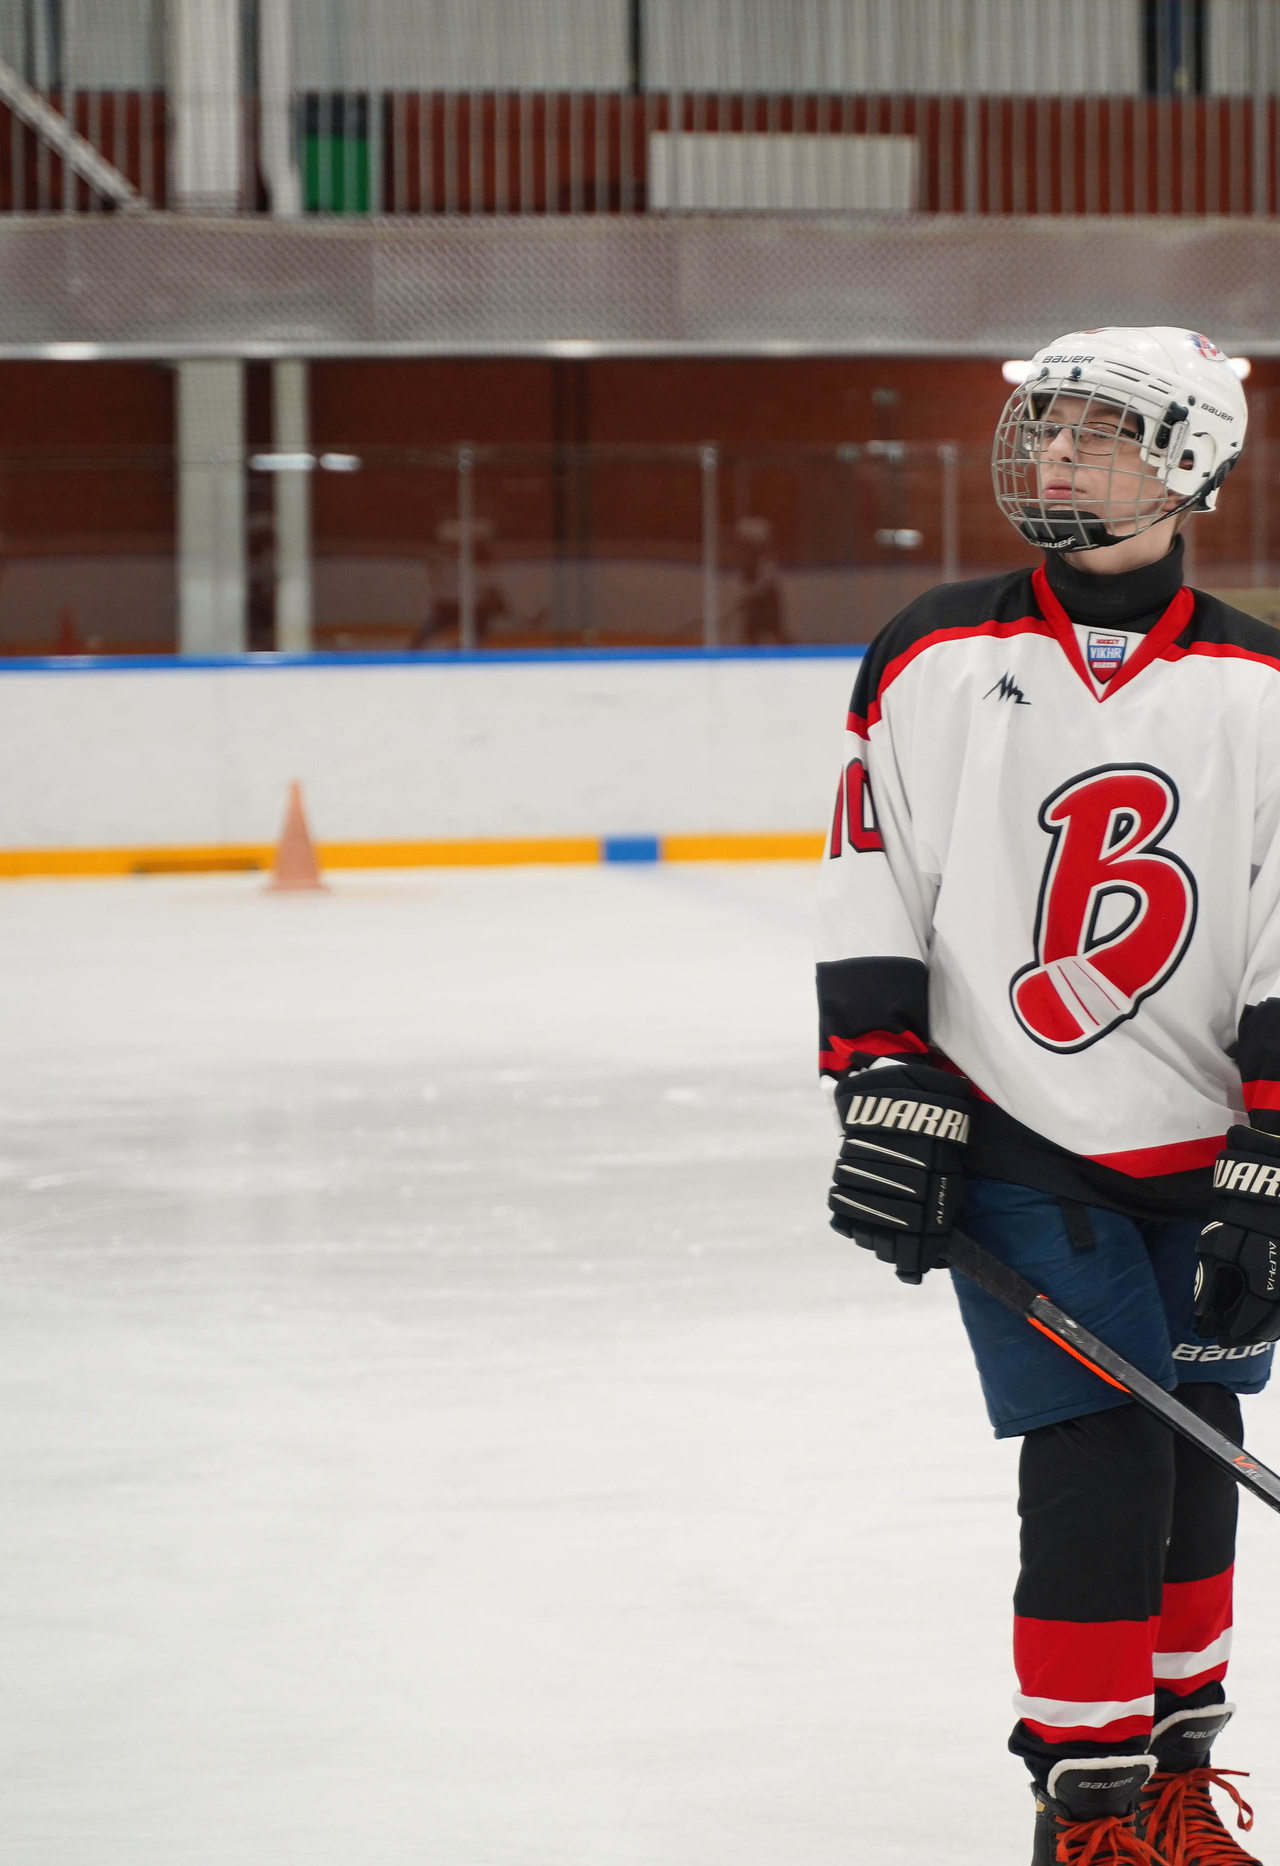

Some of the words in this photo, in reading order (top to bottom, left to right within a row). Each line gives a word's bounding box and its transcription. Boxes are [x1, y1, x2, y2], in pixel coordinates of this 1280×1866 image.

[1041, 355, 1095, 363] BAUER
[1200, 402, 1234, 423] BAUER
[1090, 646, 1122, 659] VIKHR
[1009, 762, 1198, 1054] B
[845, 1095, 970, 1144] WARRI
[1266, 1240, 1278, 1292] ALPHA
[1171, 1341, 1276, 1362] BAUE
[1078, 1776, 1135, 1790] BAUER
